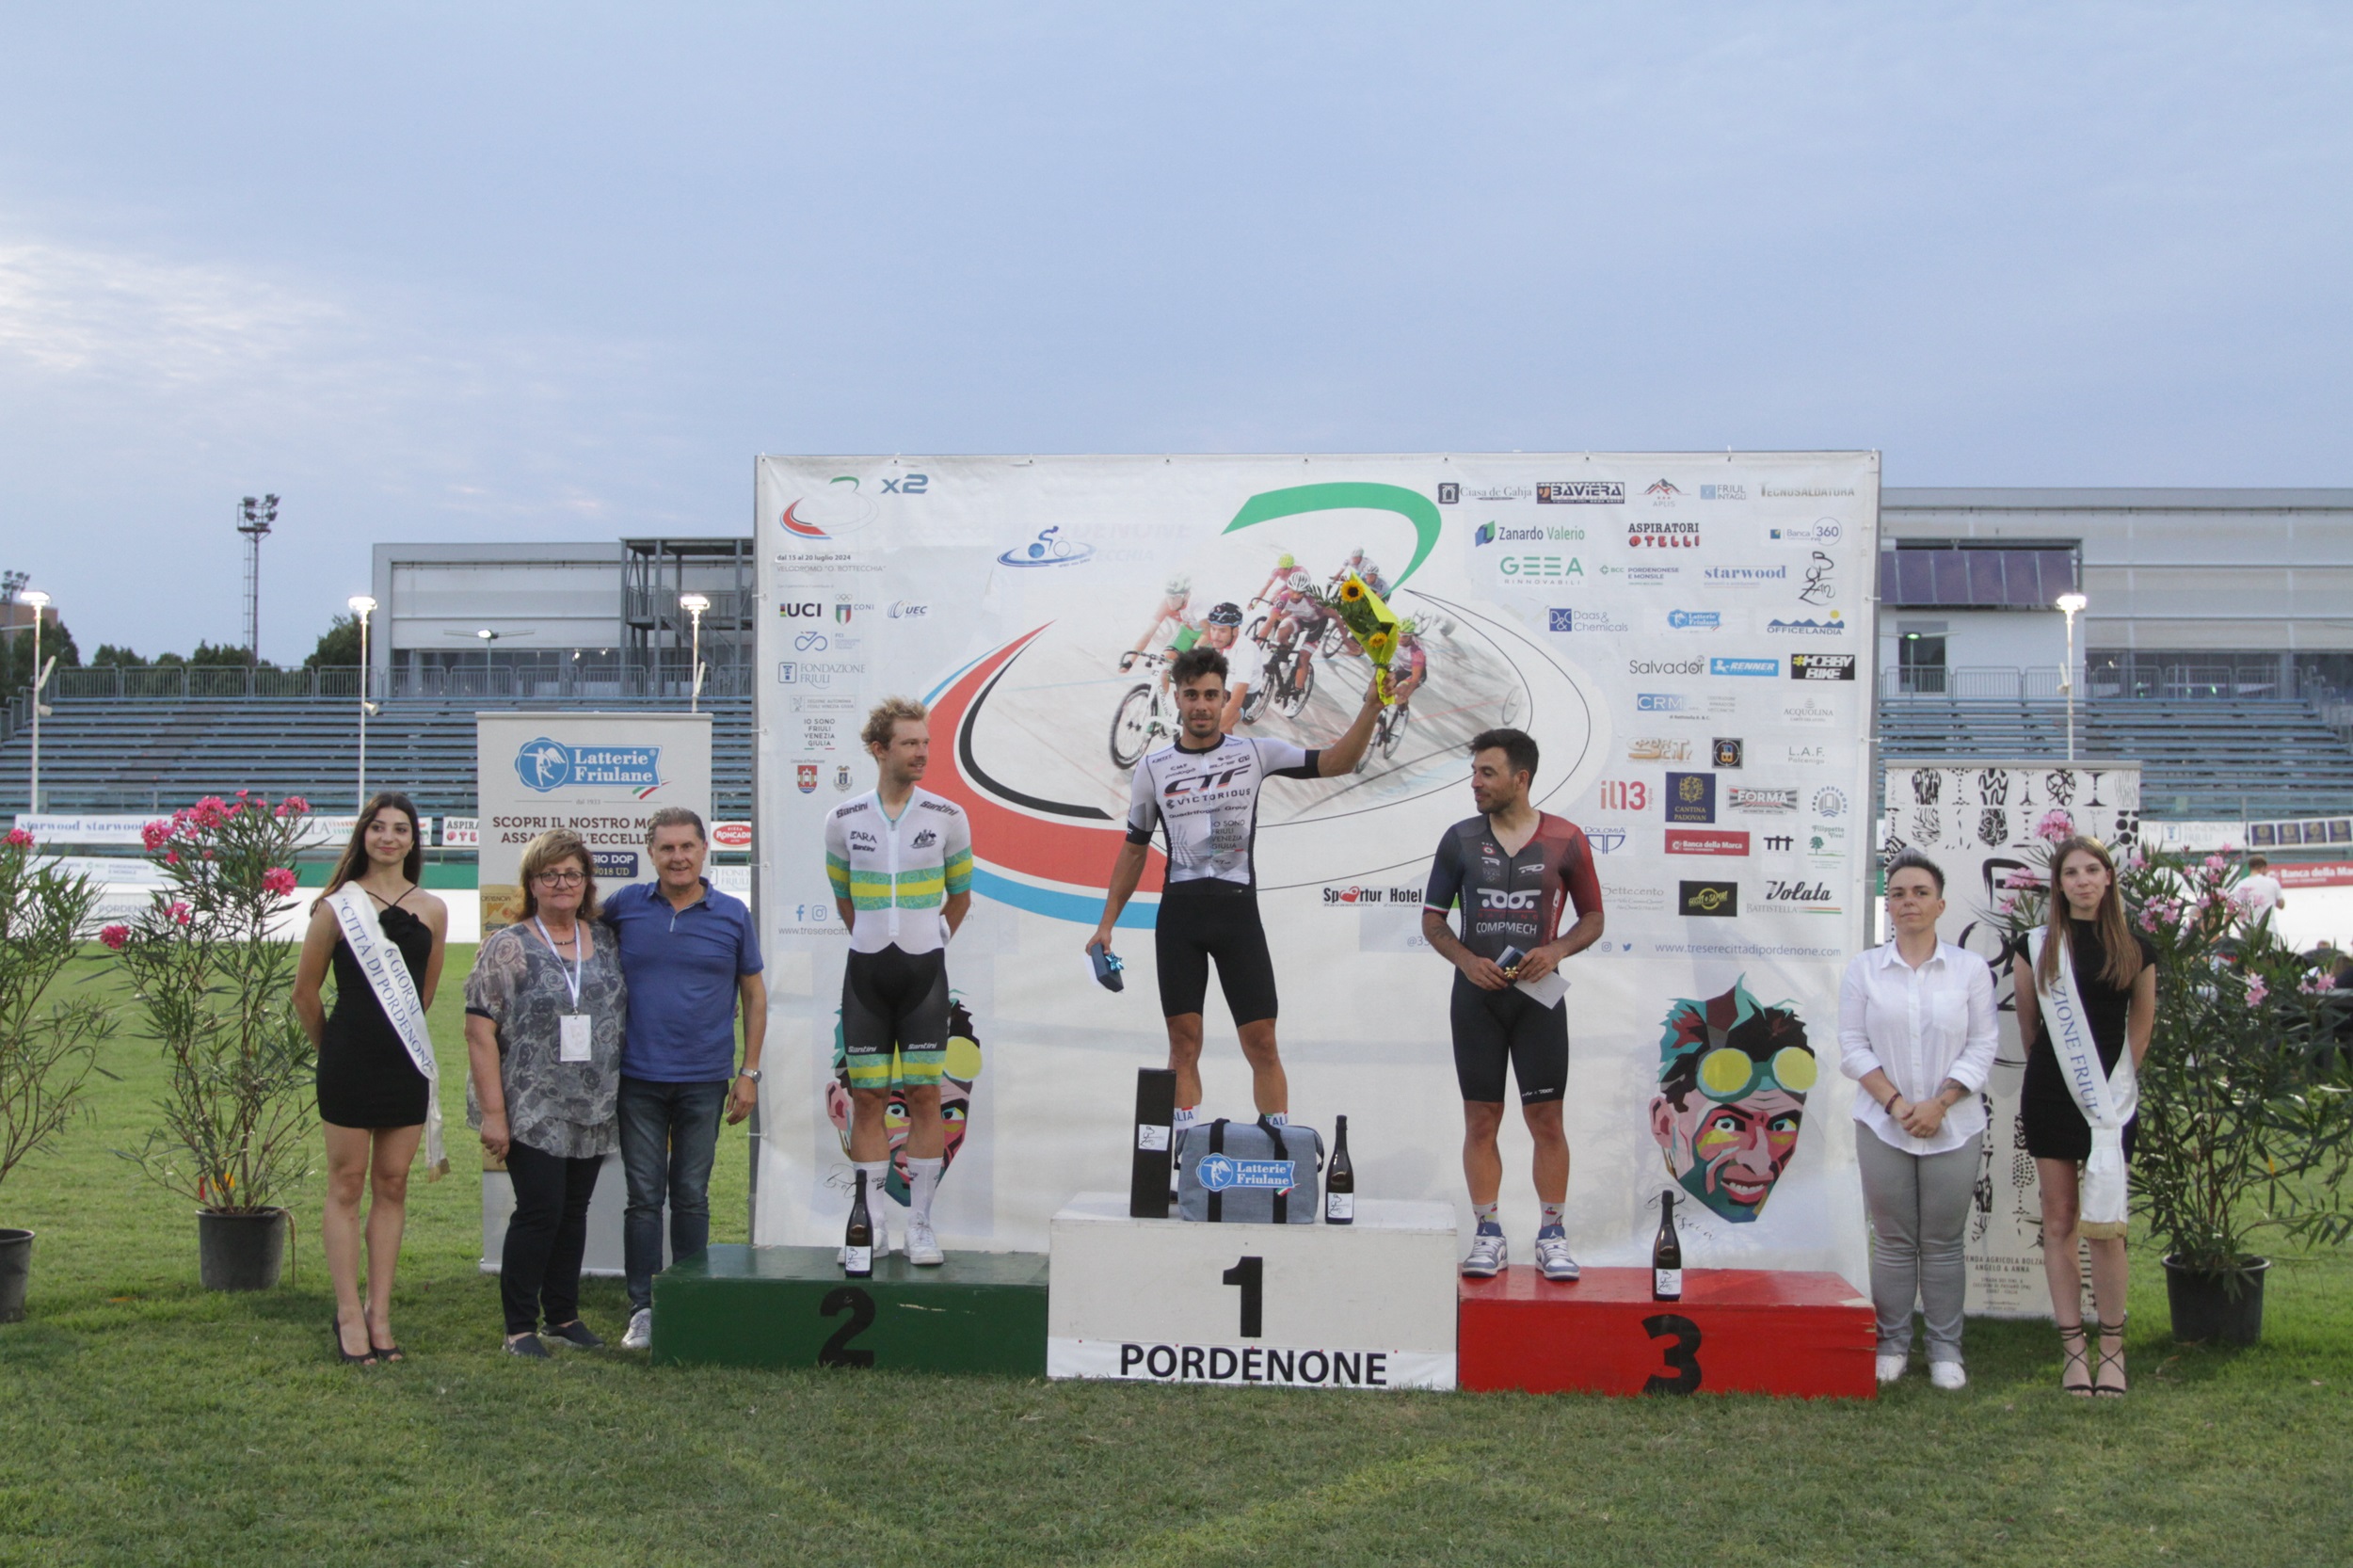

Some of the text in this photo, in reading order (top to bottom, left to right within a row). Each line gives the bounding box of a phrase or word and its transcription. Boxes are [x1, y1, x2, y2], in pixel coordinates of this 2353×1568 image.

[880, 474, 929, 494] x2
[1717, 485, 1746, 493] FRIUL
[1460, 487, 1487, 498] Ciasa
[1489, 487, 1500, 497] de
[1499, 526, 1585, 540] Zanardo Valerio
[1627, 522, 1700, 534] ASPIRATORI
[1816, 526, 1839, 537] 360
[1628, 535, 1701, 548] OTELLI
[814, 554, 834, 563] luglio
[1705, 566, 1786, 579] starwood
[787, 602, 822, 617] UCI
[905, 606, 928, 615] UEC
[1574, 611, 1600, 620] Daas
[1574, 623, 1628, 632] Chemicals
[1767, 627, 1843, 635] OFFICELANDIA
[800, 664, 866, 674] FONDAZIONE
[1629, 659, 1705, 675] Salvador
[1805, 668, 1841, 680] BIKE
[800, 674, 831, 688] FRIULI
[1638, 696, 1683, 709] CRM
[1784, 708, 1833, 716] ACQUOLINA
[574, 749, 648, 765] Latterie
[574, 766, 653, 782] Friulane
[1177, 788, 1251, 806] VICTORIOUS
[1737, 791, 1787, 803] FORMA
[836, 802, 869, 819] Santini
[920, 800, 959, 816] Santini
[492, 816, 547, 828] SCOPRI
[551, 817, 565, 828] IL
[568, 817, 630, 829] NOSTRO
[1722, 840, 1743, 849] Marca
[611, 855, 634, 864] DOP
[1390, 888, 1422, 903] Hotel
[1601, 883, 1664, 897] Settecento
[1766, 880, 1833, 901] Volata
[1746, 904, 1798, 914] BATTISTELLA
[1476, 921, 1538, 935] COMPMECH
[366, 957, 384, 977] DI
[384, 948, 421, 1016] 6 GIORNI
[848, 1045, 878, 1053] Santini
[907, 1042, 937, 1050] Santini
[1237, 1161, 1287, 1174] Latterie
[1237, 1174, 1289, 1185] Friulane
[1986, 1256, 2019, 1265] AGRICOLA
[1223, 1256, 1263, 1337] 1
[819, 1287, 875, 1367] 2
[1641, 1314, 1702, 1395] 3
[1120, 1344, 1387, 1385] PORDENONE
